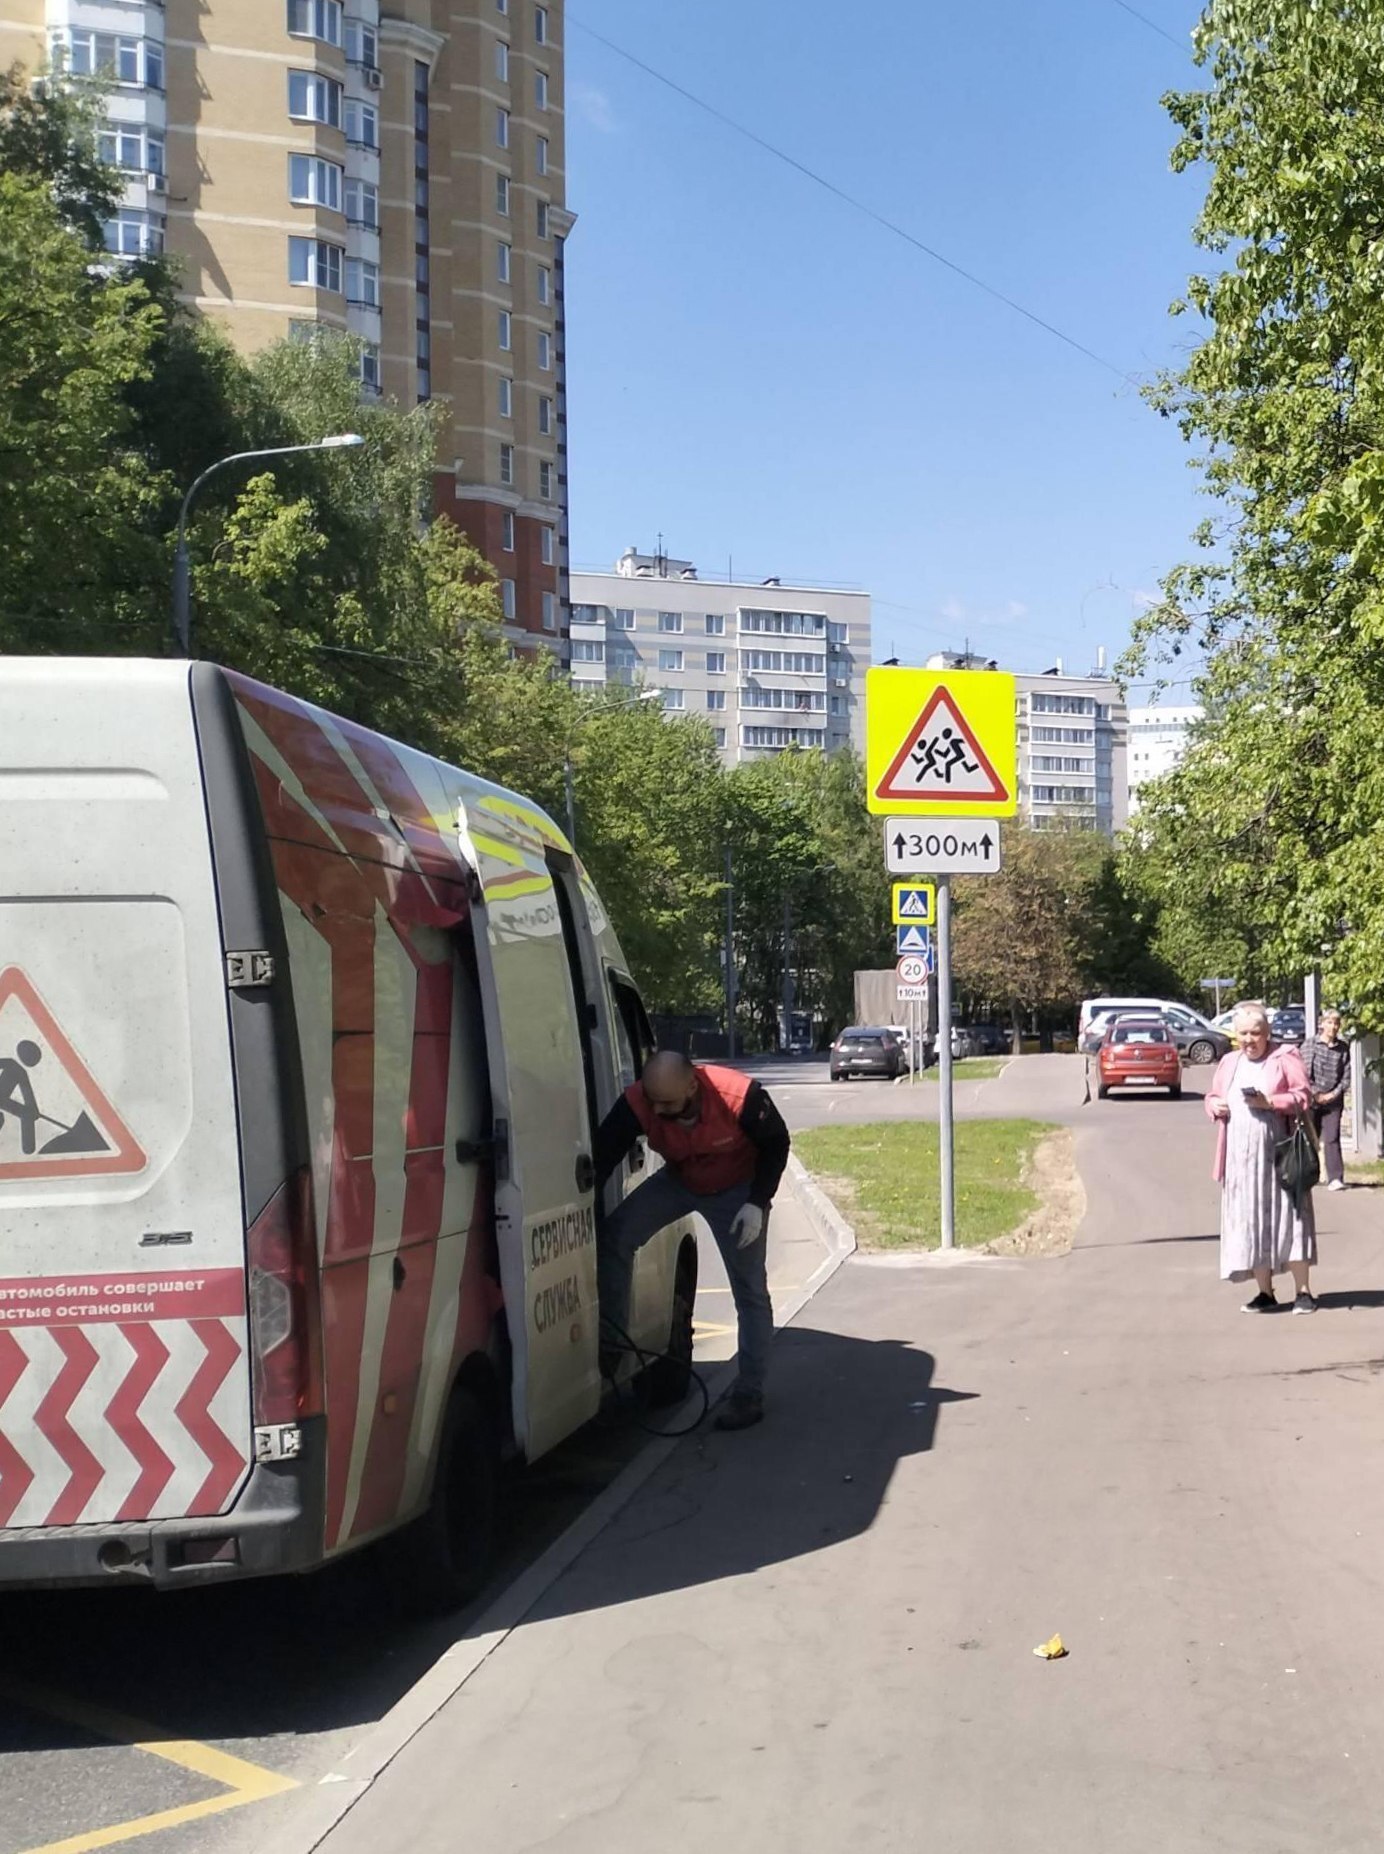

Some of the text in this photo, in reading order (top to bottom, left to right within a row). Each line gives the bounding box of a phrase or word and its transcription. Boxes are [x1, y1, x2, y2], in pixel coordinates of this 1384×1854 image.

[908, 833, 978, 857] 300м
[904, 963, 922, 976] 20
[531, 1206, 594, 1269] СЕРВИСНАЯ
[103, 1279, 205, 1296] совершает
[56, 1301, 155, 1318] остановки
[533, 1274, 582, 1334] СЛУЖБА
